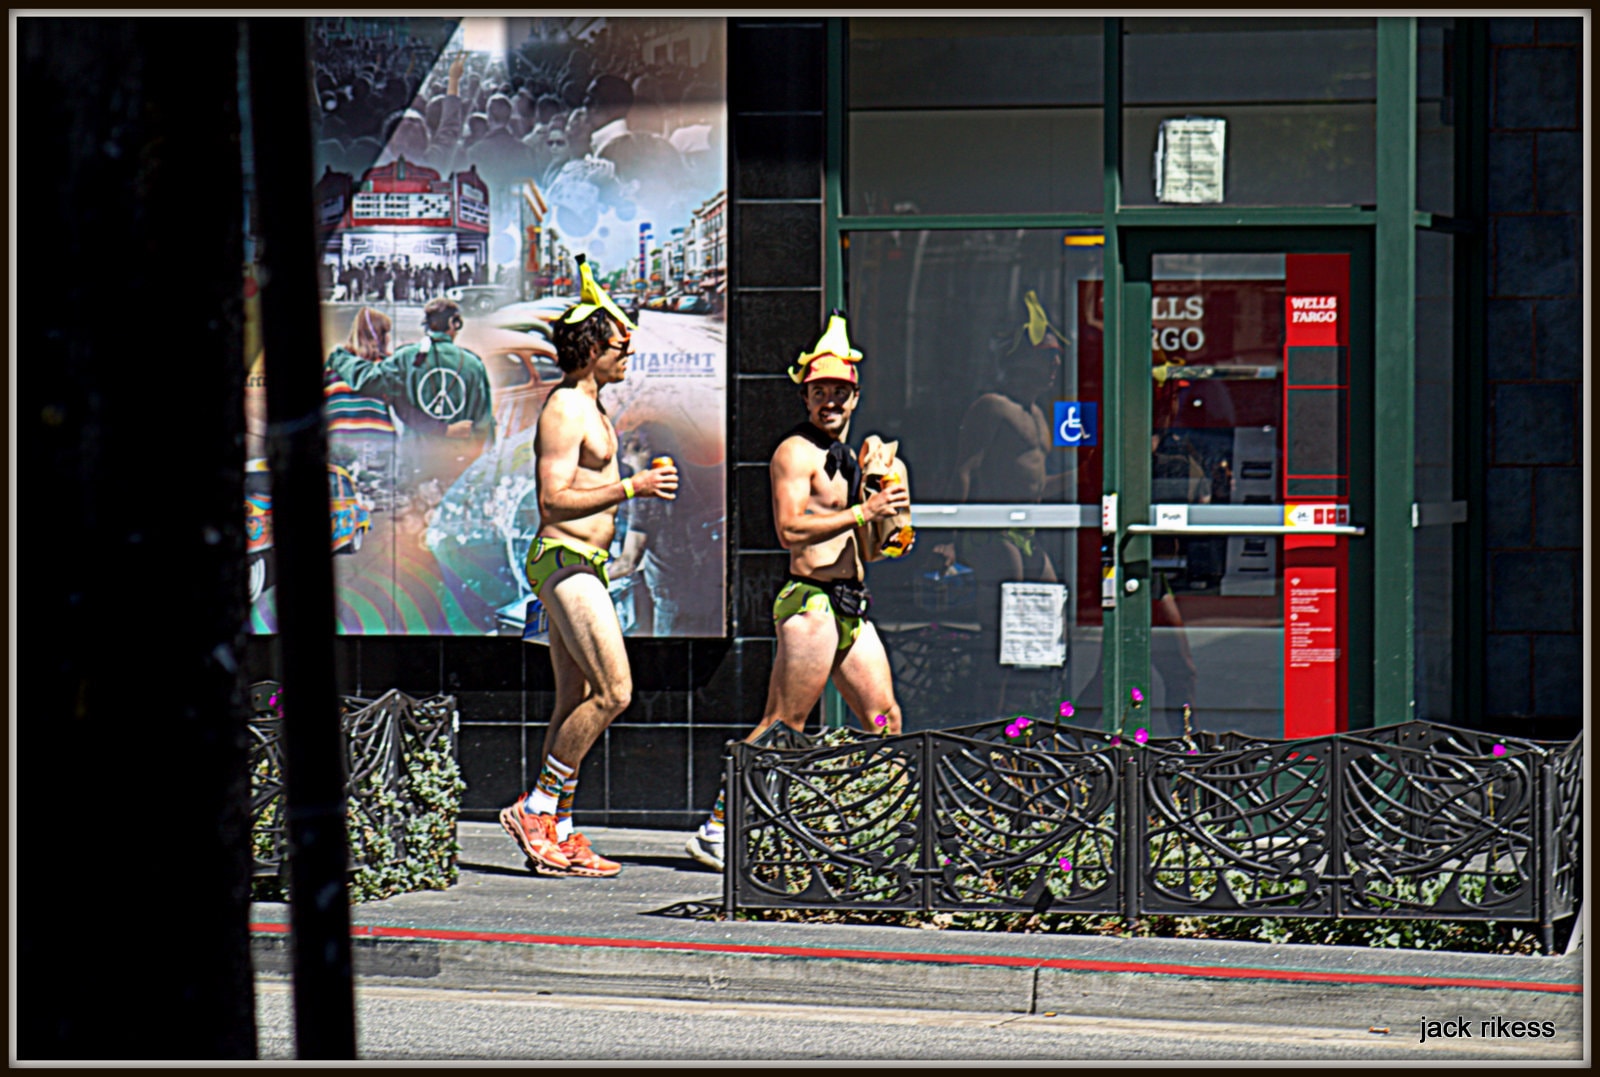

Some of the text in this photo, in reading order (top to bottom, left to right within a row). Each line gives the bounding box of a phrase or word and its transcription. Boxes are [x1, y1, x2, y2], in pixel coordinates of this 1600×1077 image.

[1291, 297, 1337, 309] WELLS
[1292, 311, 1337, 323] FARGO
[631, 352, 717, 372] HAIGHT
[1162, 512, 1182, 521] Push
